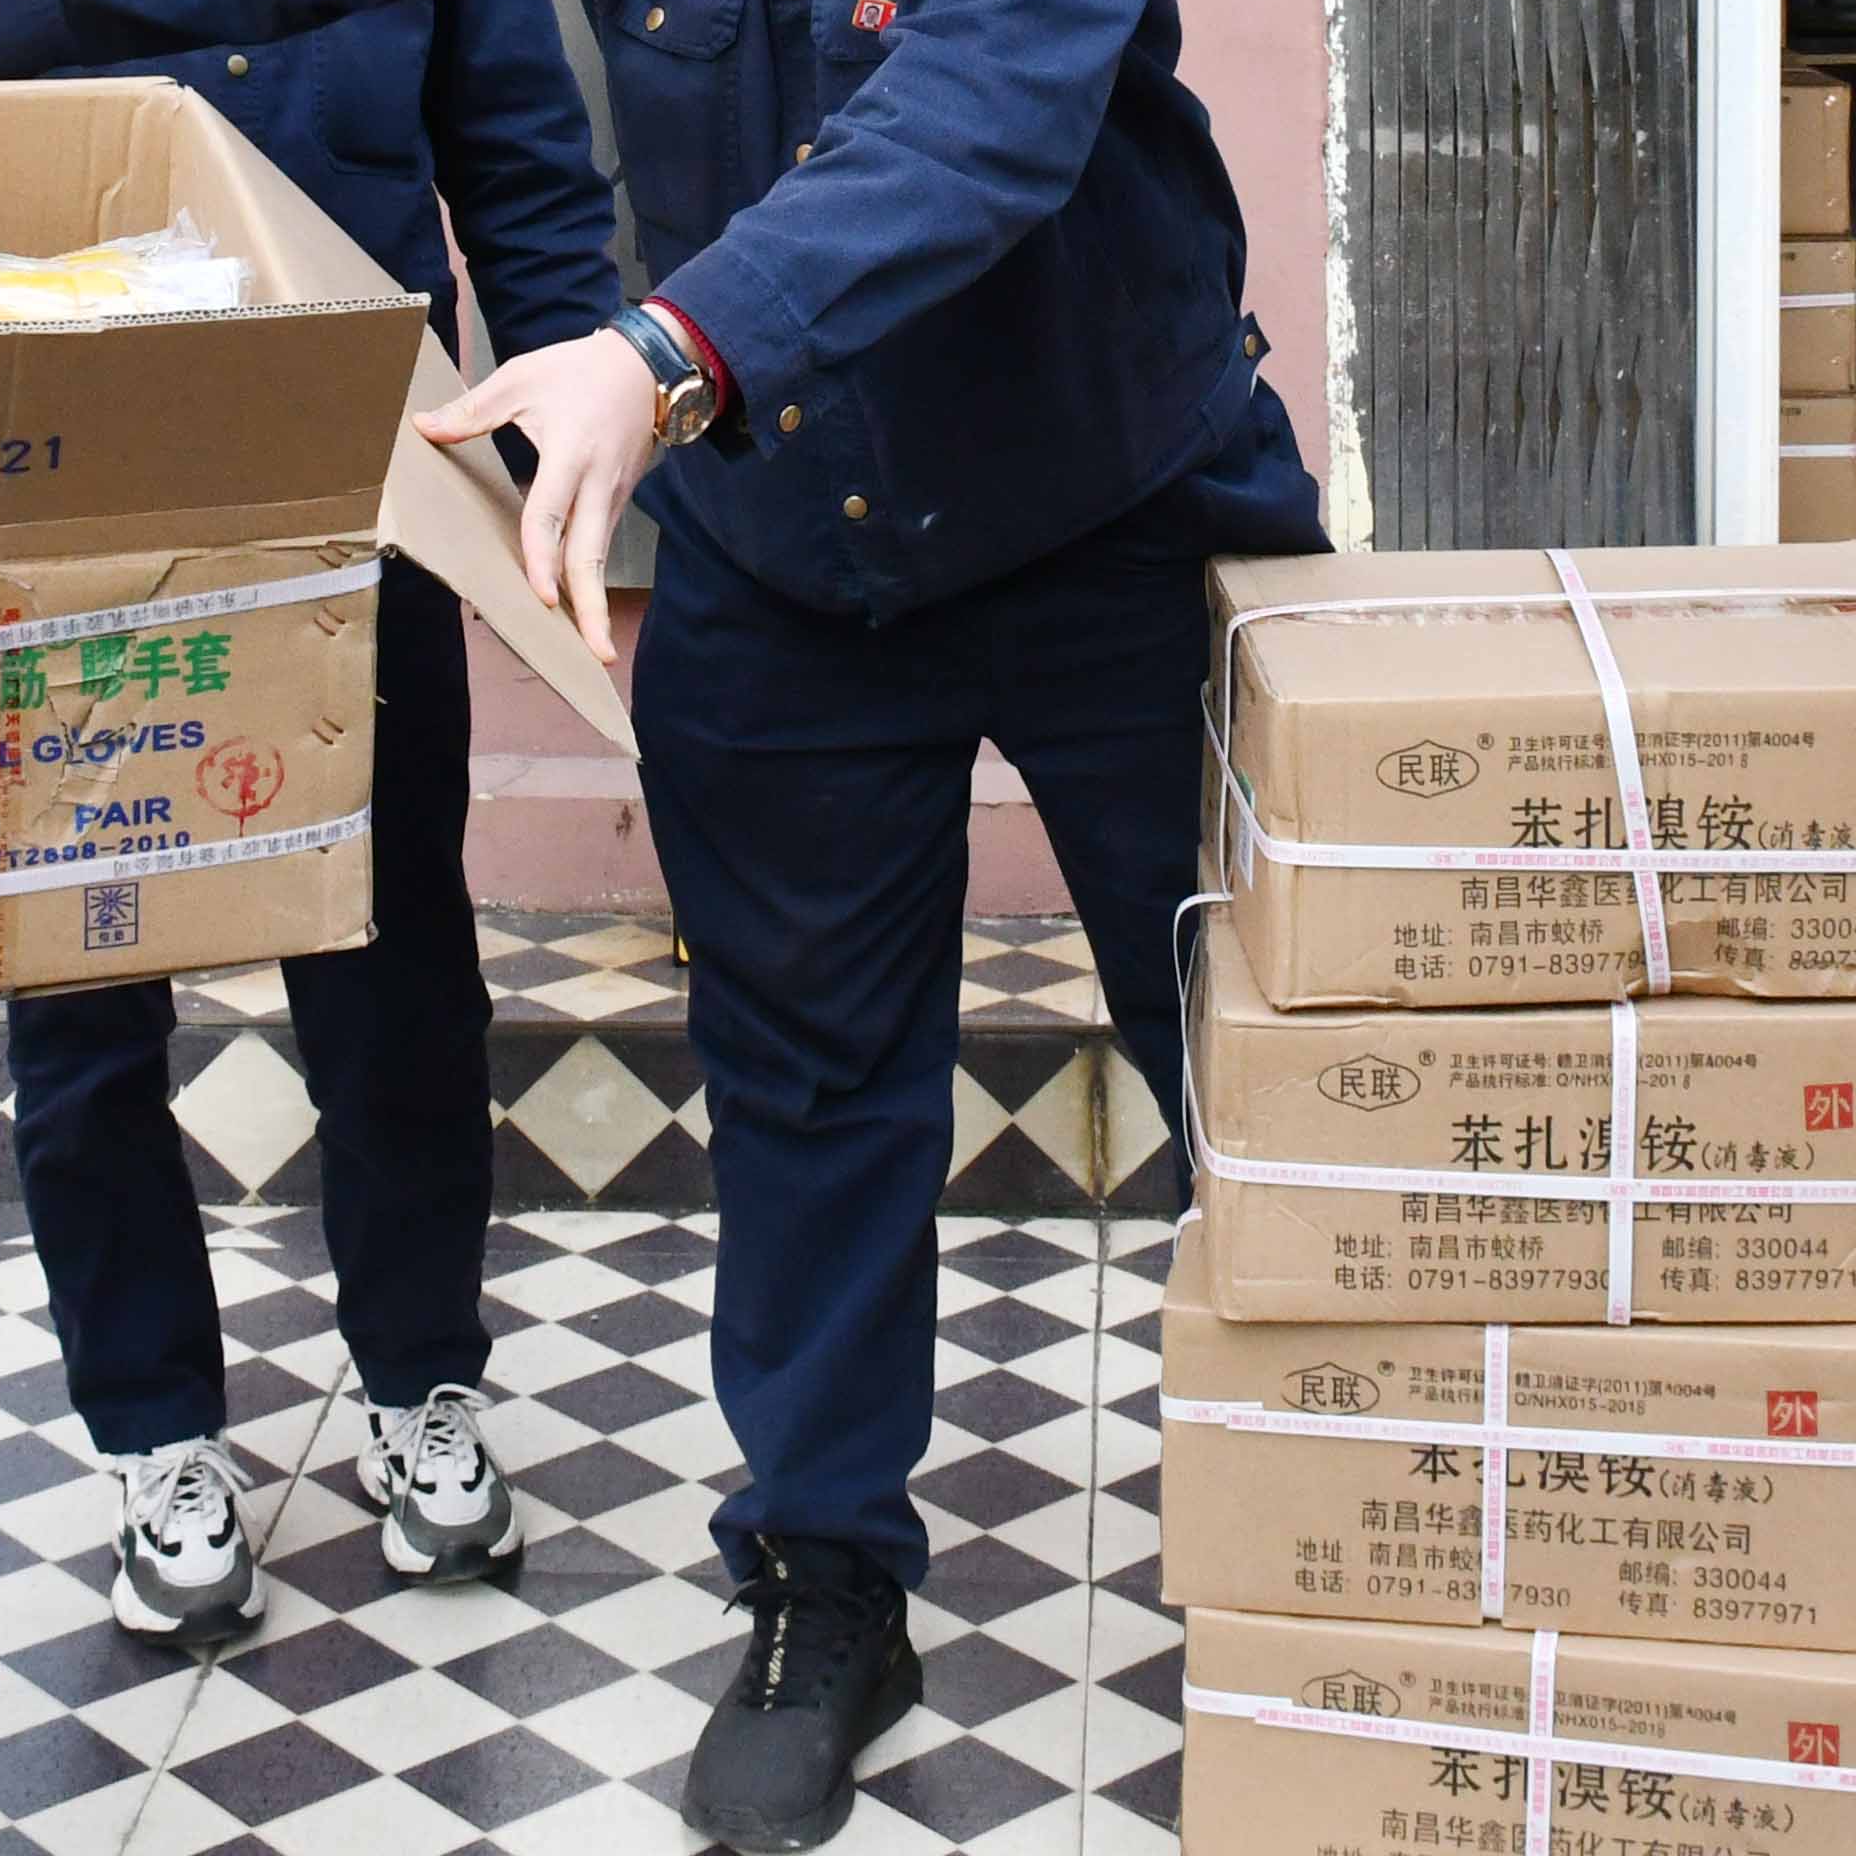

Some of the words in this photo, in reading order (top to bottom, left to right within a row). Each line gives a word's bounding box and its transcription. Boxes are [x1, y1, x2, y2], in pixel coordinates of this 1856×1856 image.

[32, 720, 205, 765] GLOVES
[1398, 754, 1459, 786] 民联
[74, 797, 173, 833] PAIR
[1470, 919, 1603, 946] 南昌市蛟桥
[1469, 950, 1646, 977] 0791-839779
[1557, 1054, 1757, 1070] 赣卫消(2011)第A004号
[1340, 1069, 1401, 1100] 民联
[1808, 1086, 1852, 1128] 外
[1409, 1235, 1544, 1261] 南昌市蛟桥
[1736, 1237, 1828, 1259] 330044
[1300, 1374, 1361, 1410] 民联
[1771, 1396, 1815, 1434] 外
[1369, 1542, 1482, 1571] 南昌市蛟
[1694, 1567, 1787, 1592] 330044
[1367, 1575, 1570, 1607] 0791-837930
[1693, 1597, 1816, 1625] 83977971
[1322, 1681, 1381, 1717] 民联
[1791, 1727, 1835, 1765] 外
[1381, 1808, 1773, 1856] 南昌华鑫药化工有
